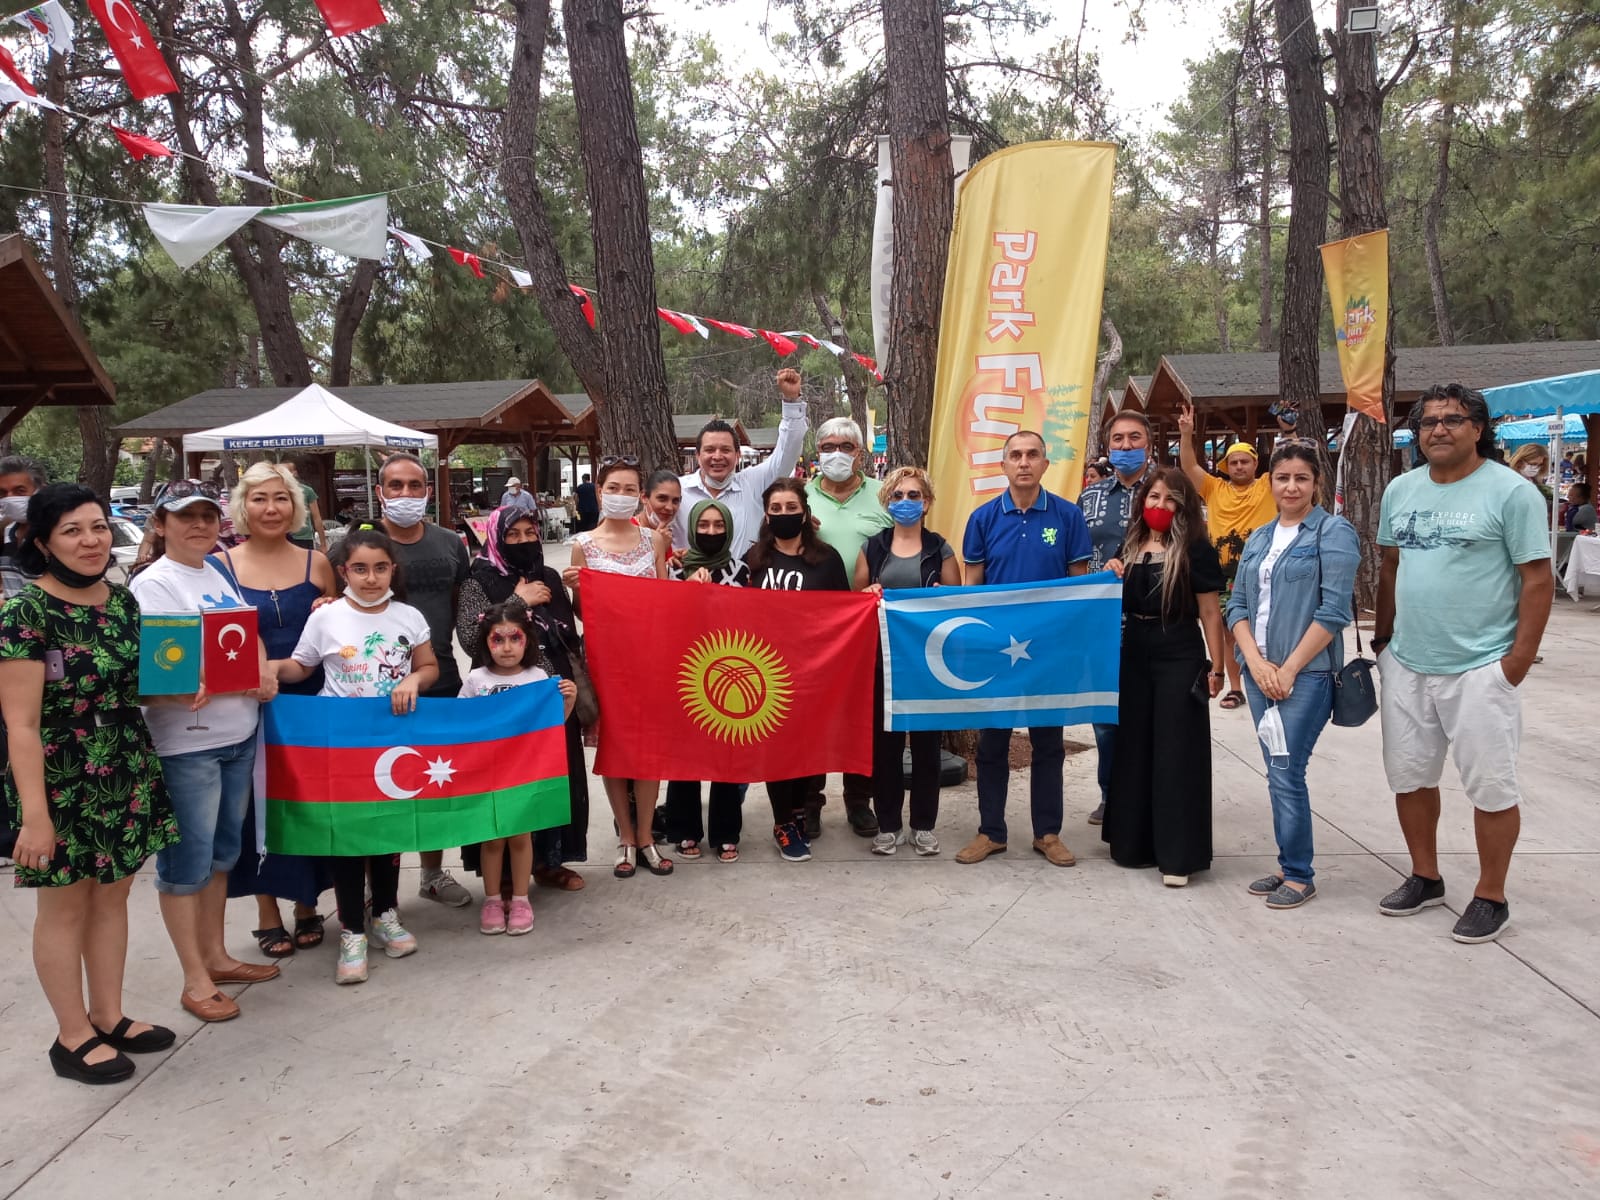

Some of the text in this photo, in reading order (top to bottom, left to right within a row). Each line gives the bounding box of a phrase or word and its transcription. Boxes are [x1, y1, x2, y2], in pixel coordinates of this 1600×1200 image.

[985, 230, 1038, 343] Park
[229, 435, 318, 449] KEPEZ BELEDİYESİ
[1431, 511, 1475, 523] EXPLORE
[334, 672, 374, 684] PALMS
